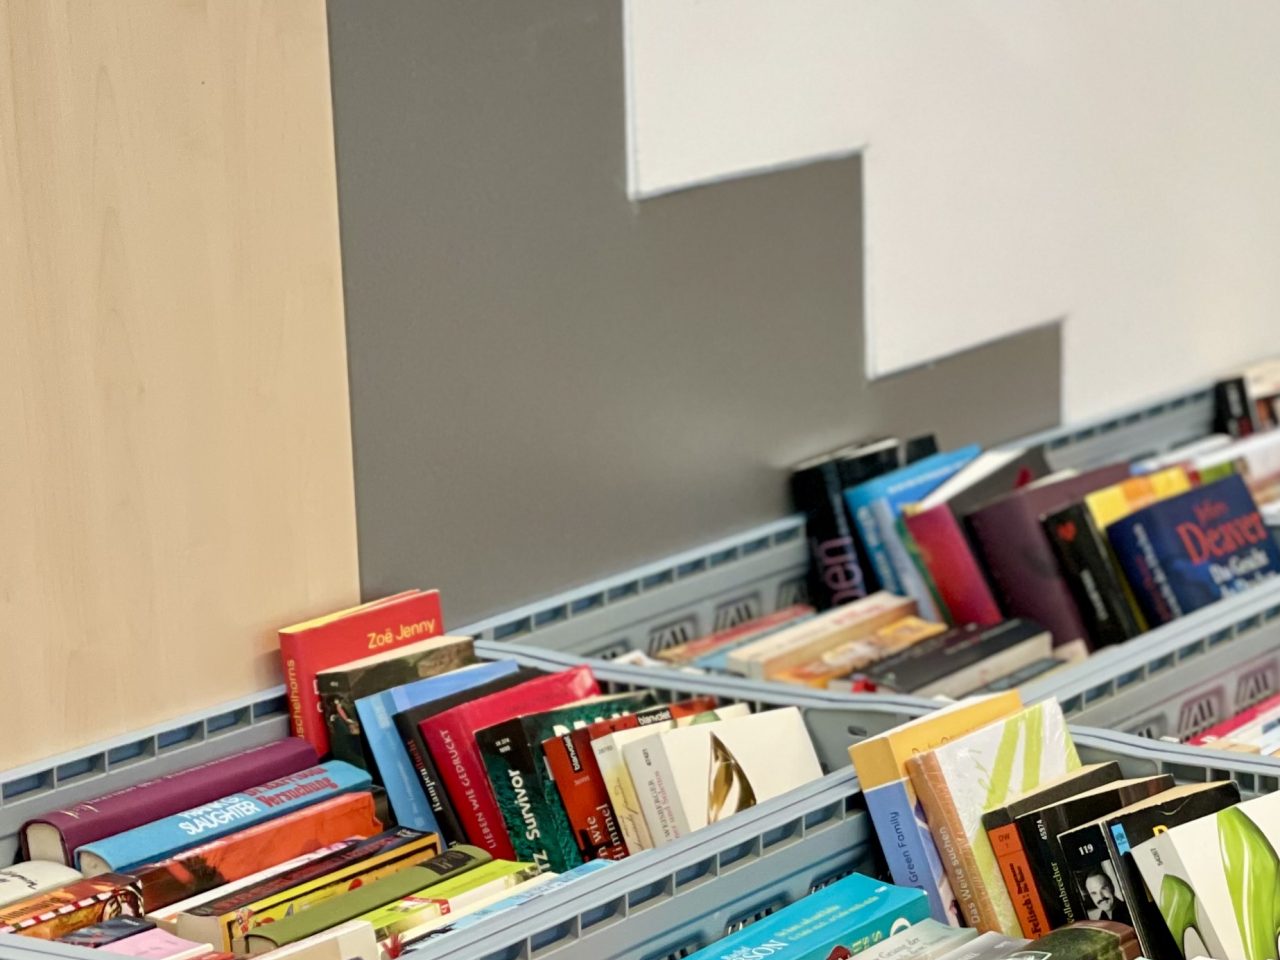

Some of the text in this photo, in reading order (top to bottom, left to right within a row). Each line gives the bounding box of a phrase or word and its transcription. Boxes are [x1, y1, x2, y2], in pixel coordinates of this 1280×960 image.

[367, 618, 436, 649] Zoë Jenny
[286, 658, 305, 740] uschelhorns
[637, 709, 672, 726] blanvalet
[440, 729, 497, 850] LIEBEN WIE GEDRUCKT
[508, 769, 541, 841] Survivor
[178, 800, 260, 835] SLAUGHTER
[586, 815, 602, 843] wie
[889, 811, 919, 882] Green Family
[1077, 843, 1094, 856] 119
[939, 826, 980, 923] Das Weite suchen
